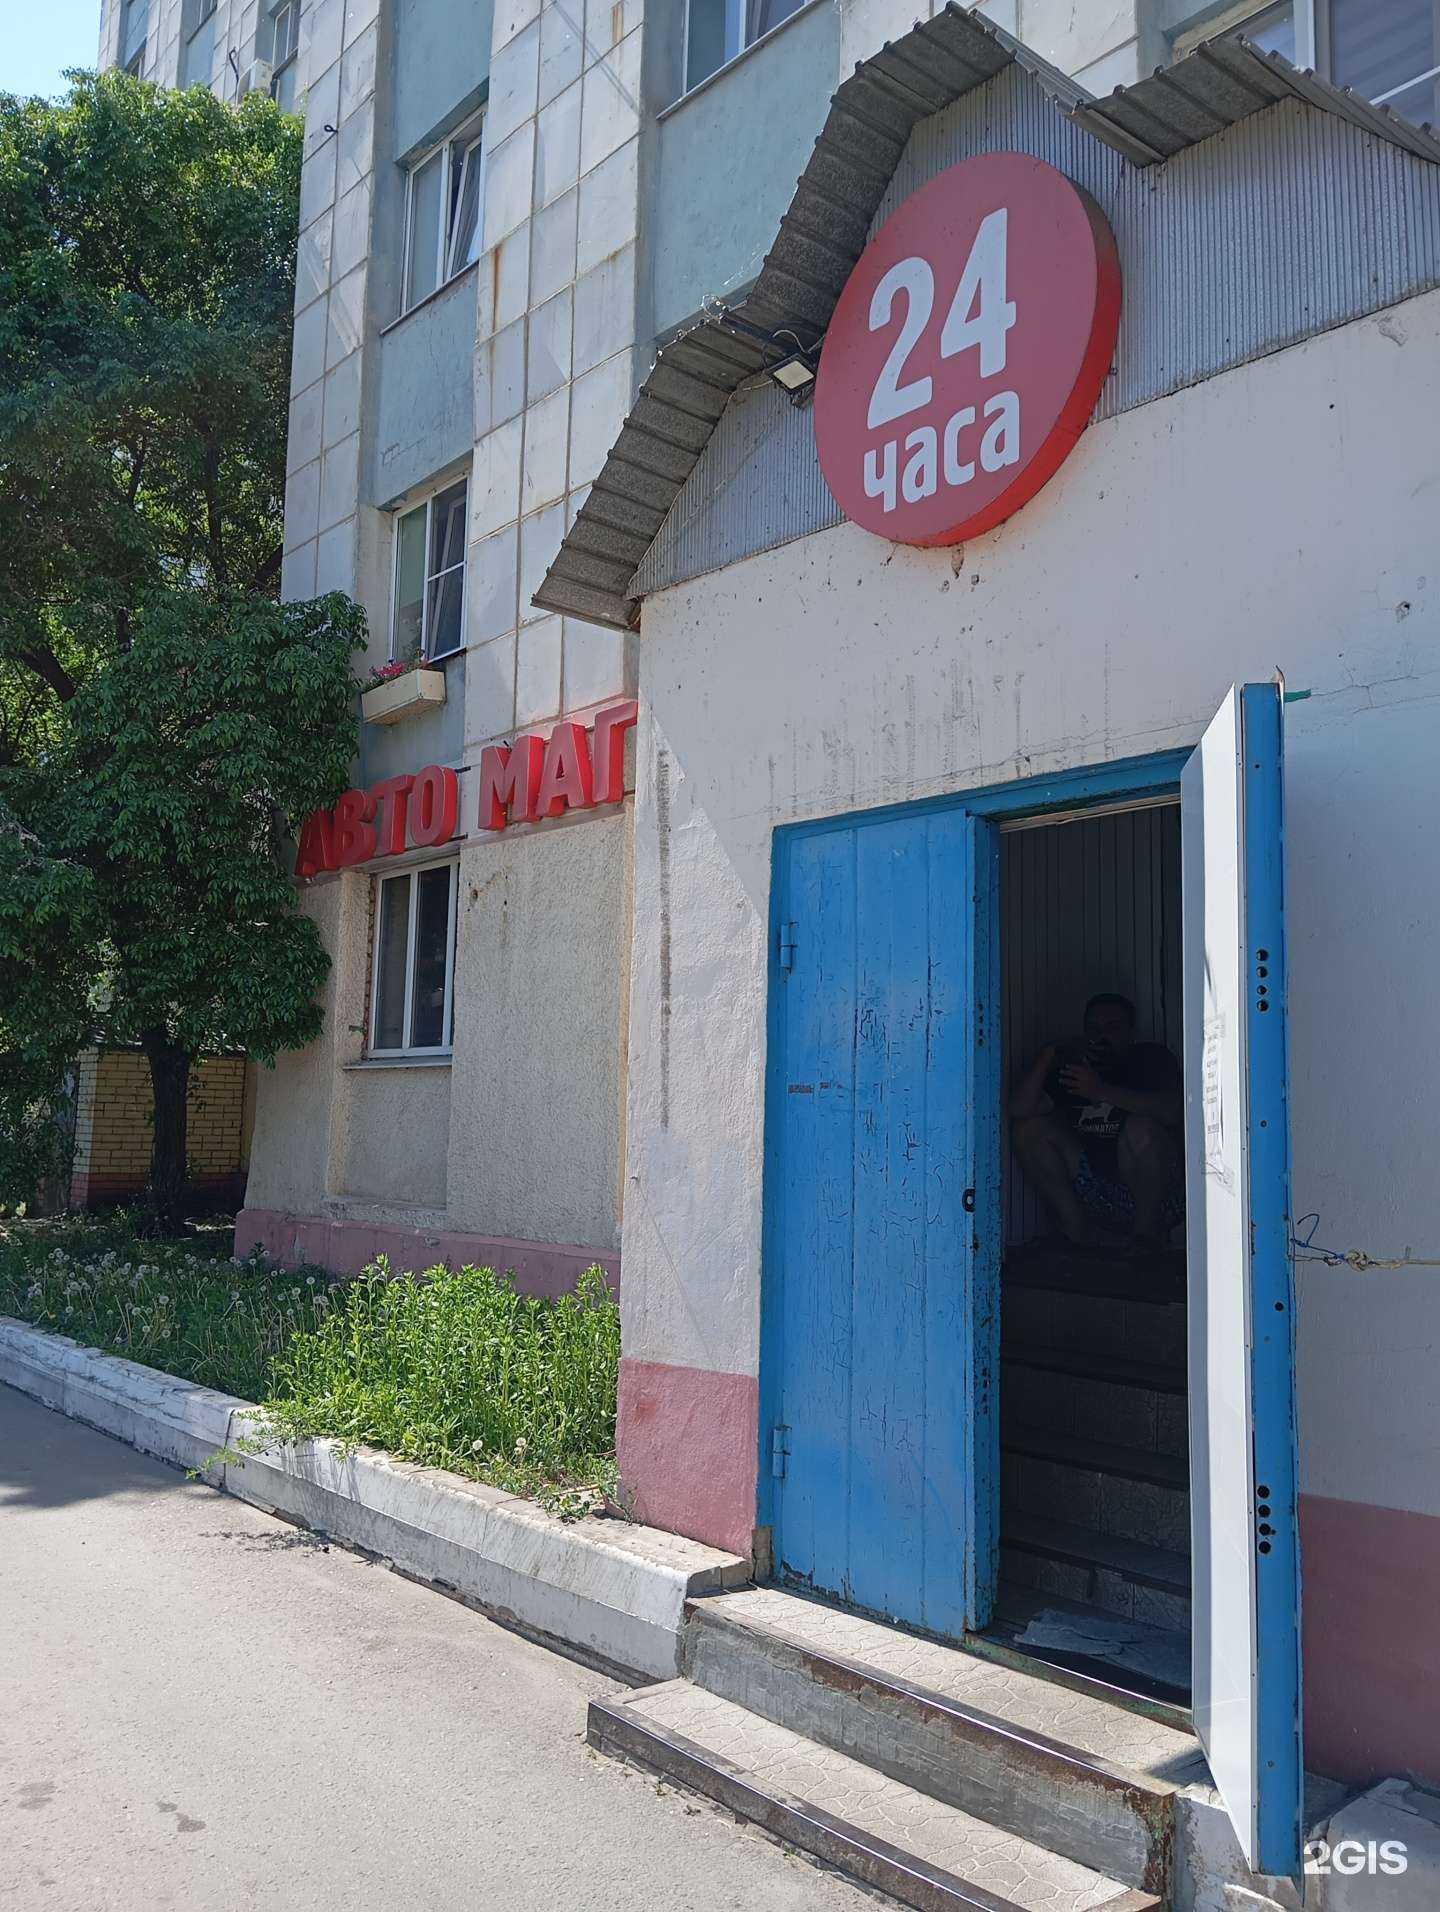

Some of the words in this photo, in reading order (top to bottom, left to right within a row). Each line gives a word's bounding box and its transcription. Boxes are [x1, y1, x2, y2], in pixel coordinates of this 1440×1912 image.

[867, 207, 1017, 429] 24
[863, 390, 1020, 513] часа
[294, 764, 458, 876] АВТО
